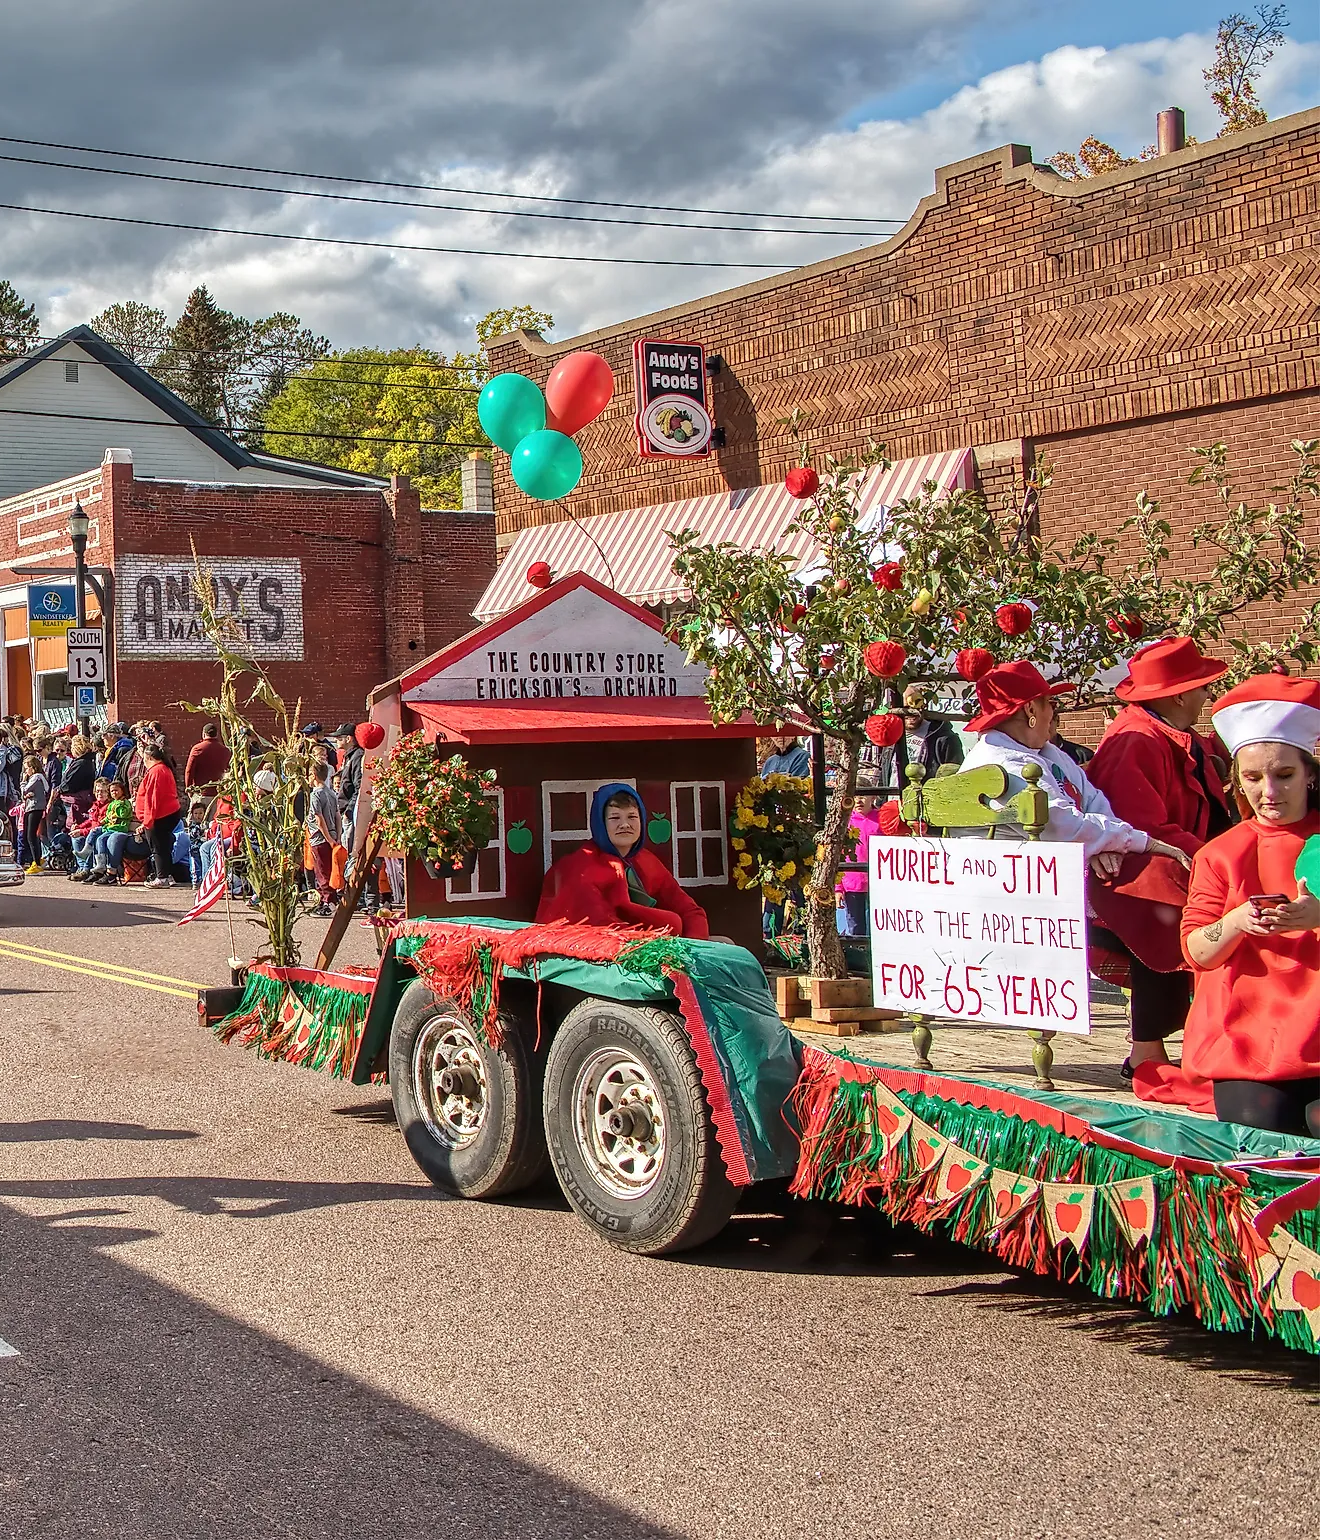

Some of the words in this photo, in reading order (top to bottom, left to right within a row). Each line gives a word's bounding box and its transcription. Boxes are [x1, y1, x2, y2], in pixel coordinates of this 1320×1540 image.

[648, 351, 699, 371] Andy's
[651, 371, 698, 390] Foods
[69, 631, 101, 644] SOUTH
[75, 657, 98, 679] 13
[488, 651, 519, 673] THE
[529, 651, 606, 674] COUNTRY
[615, 652, 665, 675] STORE
[476, 677, 581, 700] ERICKSON'S
[603, 677, 677, 697] ORCHARD
[877, 848, 955, 885] MURIEL
[962, 857, 997, 878] AND
[1002, 854, 1058, 896] JIM
[874, 908, 925, 934] UNDER
[934, 911, 973, 940] THE
[981, 912, 1084, 950] APPLETREE
[881, 962, 927, 1001] FOR
[944, 965, 983, 1016] 65
[997, 974, 1078, 1021] YEARS
